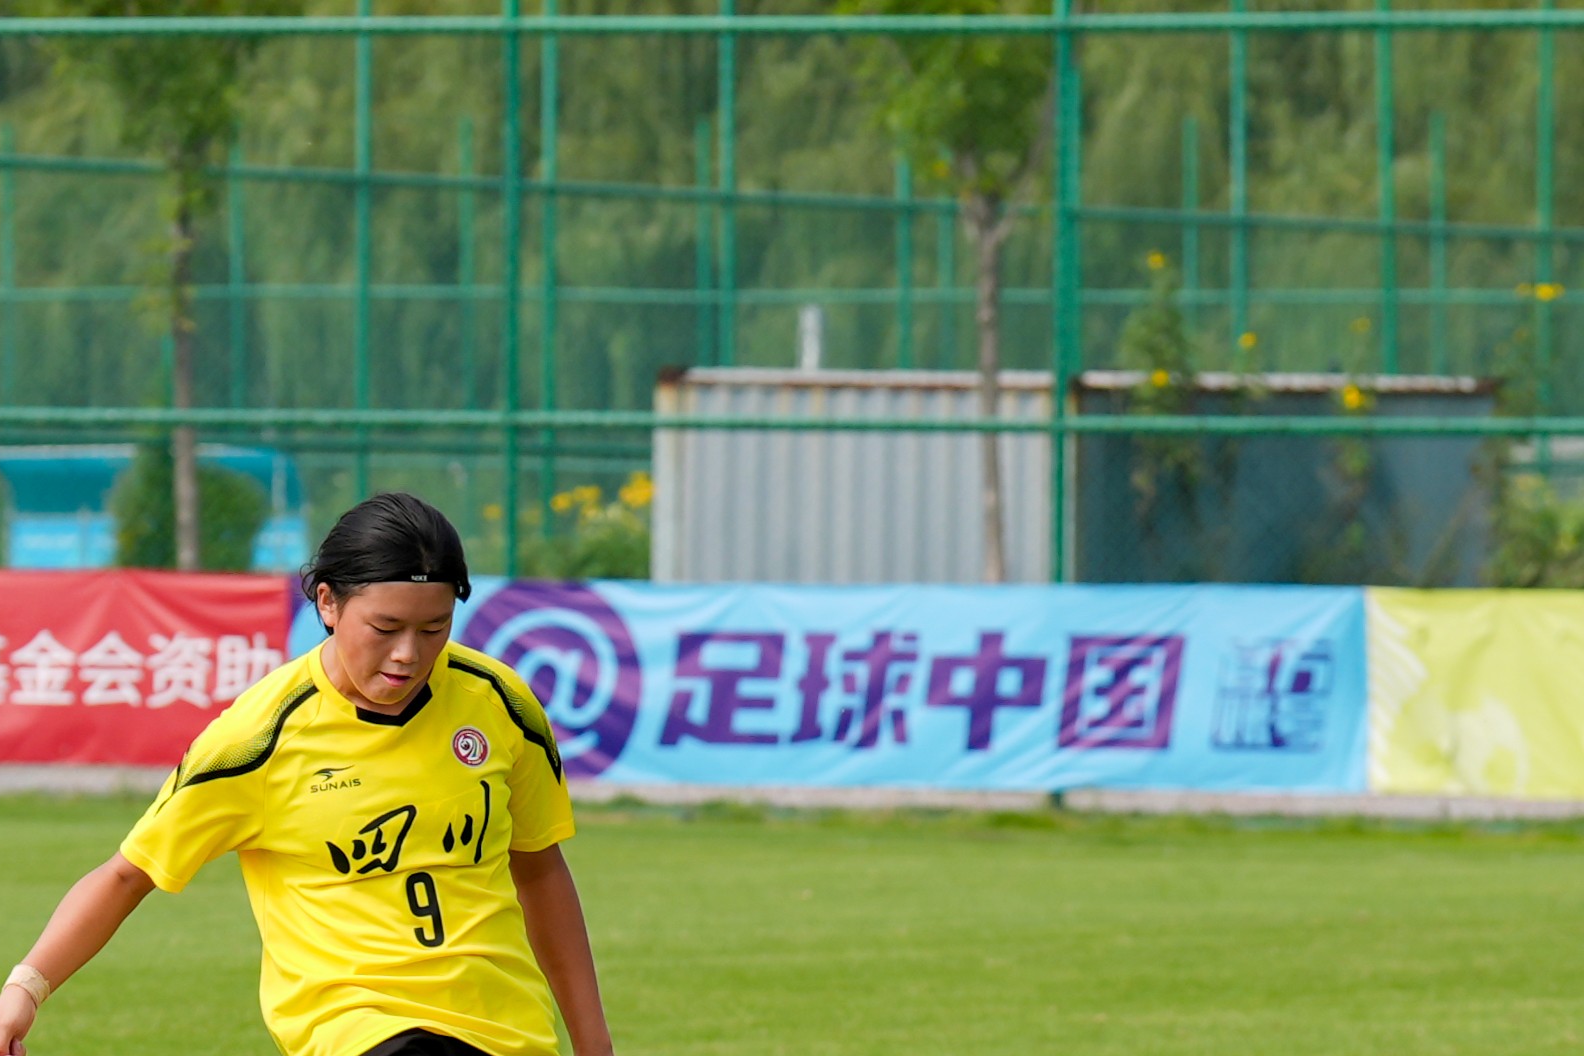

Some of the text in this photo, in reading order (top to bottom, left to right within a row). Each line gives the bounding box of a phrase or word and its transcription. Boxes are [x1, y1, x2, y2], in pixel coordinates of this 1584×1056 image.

[310, 778, 362, 794] SUNAIS
[325, 779, 491, 875] 四川
[405, 871, 445, 948] 9
